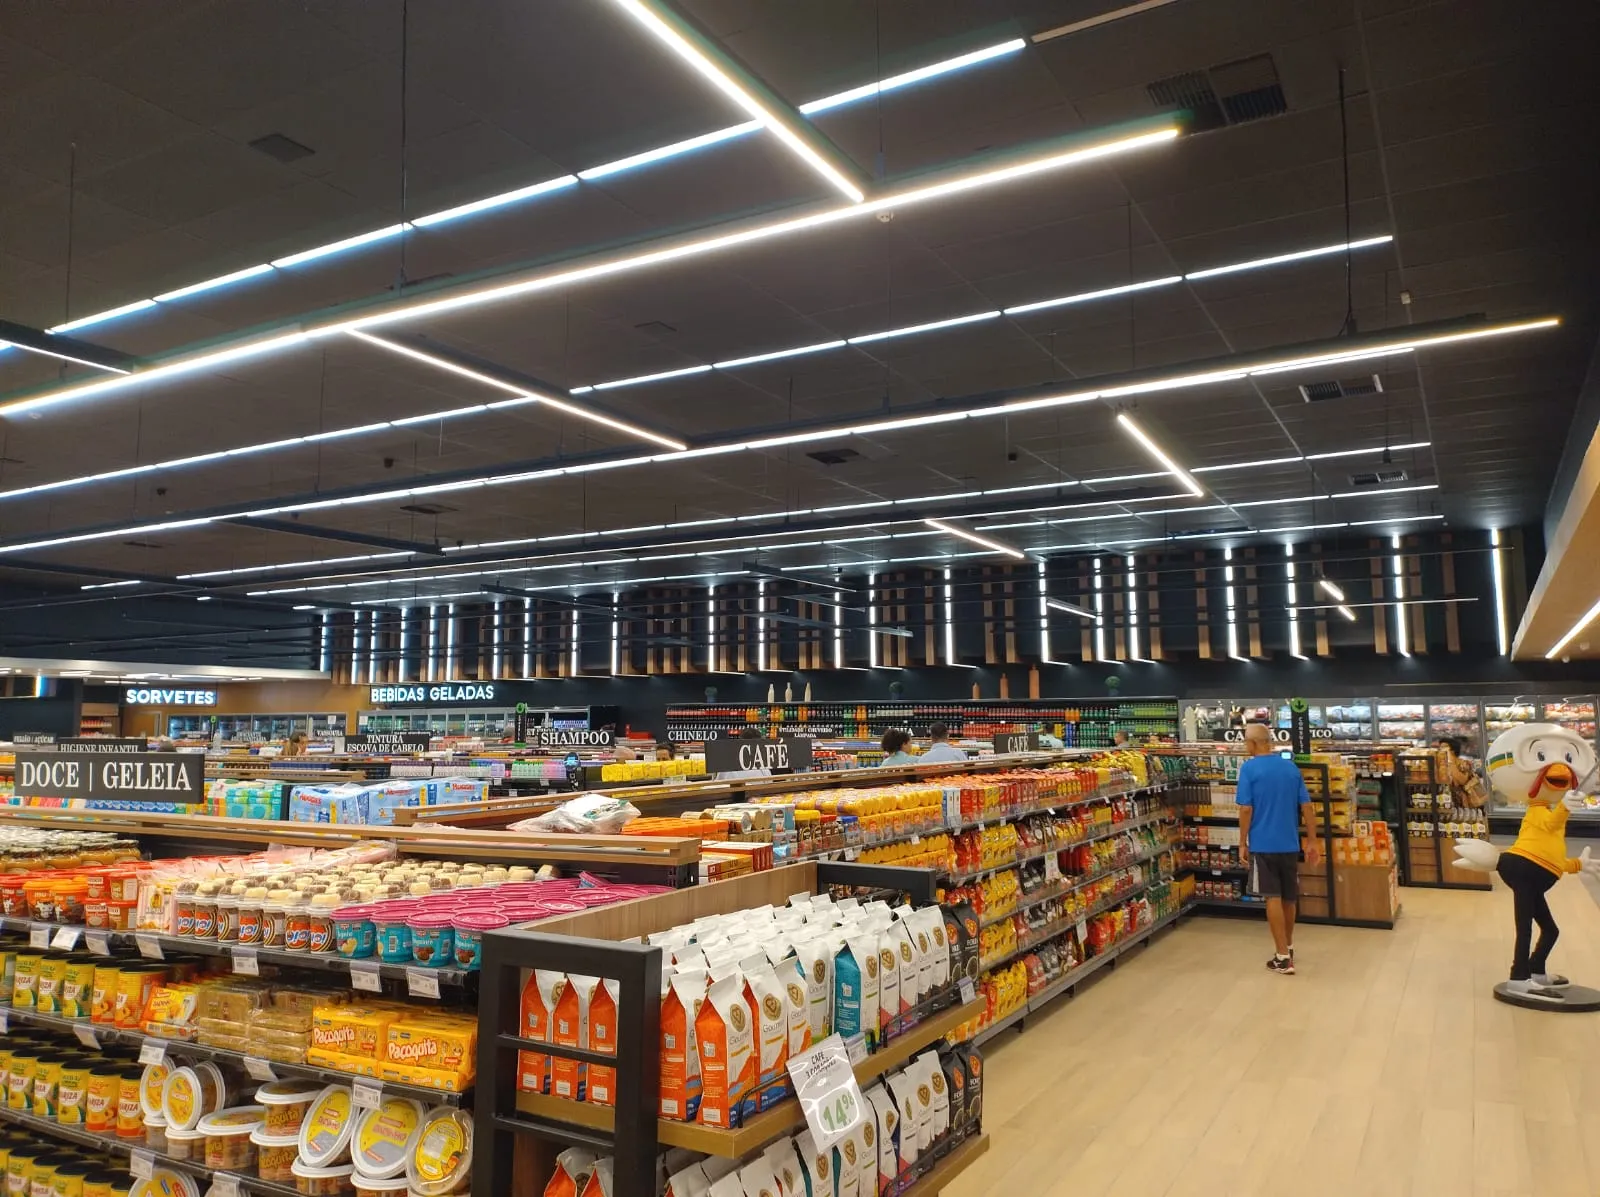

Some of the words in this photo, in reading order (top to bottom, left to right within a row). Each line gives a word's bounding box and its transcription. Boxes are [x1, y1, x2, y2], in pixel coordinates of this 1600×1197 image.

[126, 689, 215, 705] SORVETES
[371, 687, 425, 702] BEBIDAS
[430, 685, 494, 701] GELADAS
[367, 734, 404, 743] TINTURA
[540, 731, 610, 745] SHAMPOO
[668, 730, 718, 741] CHINELO
[1007, 733, 1029, 753] CAFÉ
[60, 743, 96, 752] HIGIENE
[347, 744, 377, 753] ESCOVA
[379, 744, 389, 752] DE
[391, 744, 424, 753] CABELO
[739, 739, 789, 771] CAFÉ
[21, 761, 79, 788] DOCE
[102, 761, 192, 791] GELEIA
